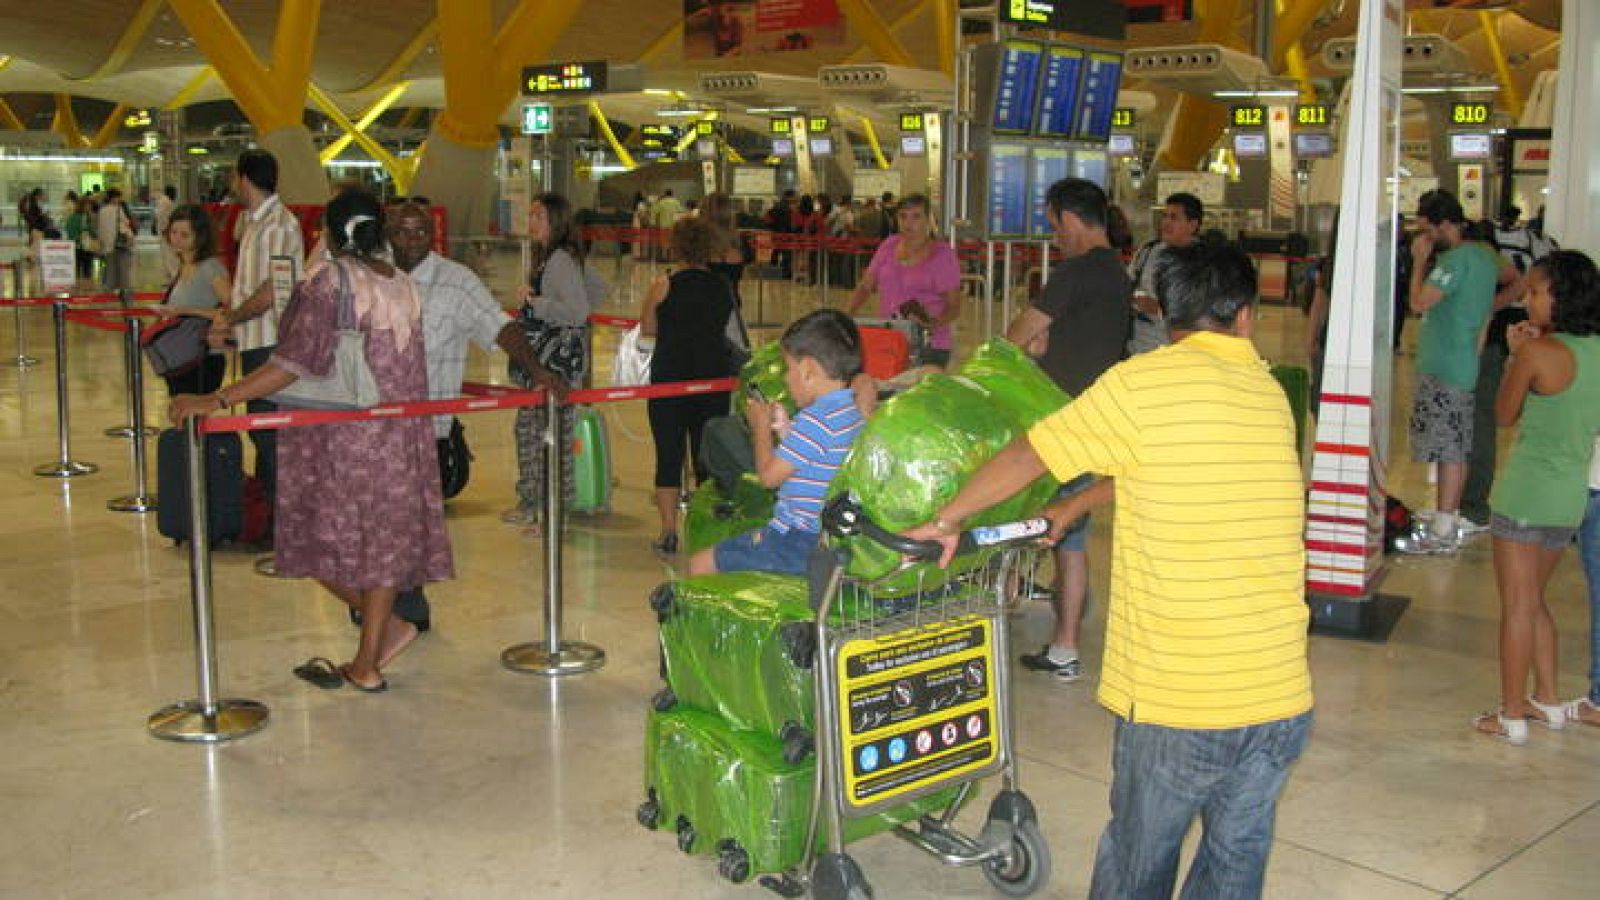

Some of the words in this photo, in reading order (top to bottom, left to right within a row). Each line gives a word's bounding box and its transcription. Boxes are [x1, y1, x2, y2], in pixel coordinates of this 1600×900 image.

[1112, 110, 1130, 126] 13
[1235, 108, 1262, 125] 812
[1299, 107, 1325, 123] 811
[1454, 104, 1488, 123] 810
